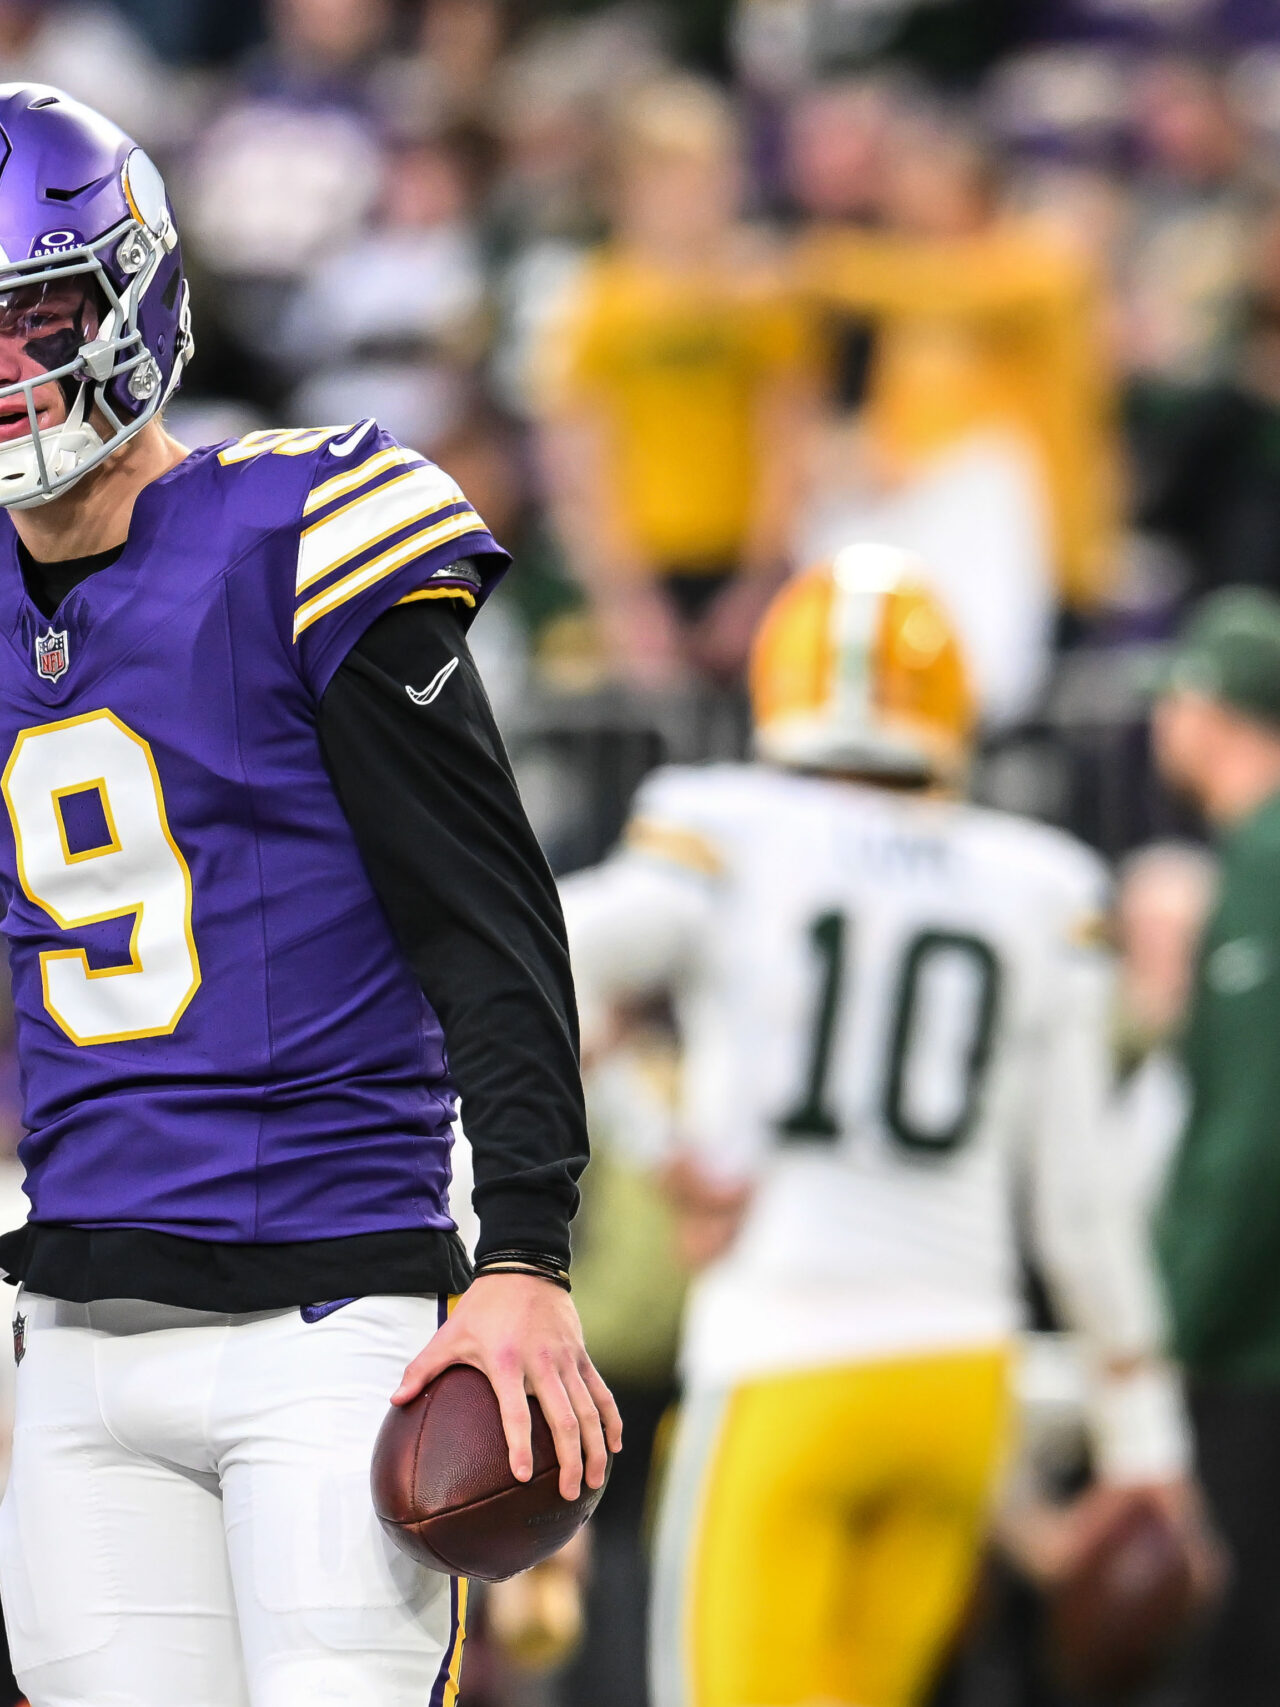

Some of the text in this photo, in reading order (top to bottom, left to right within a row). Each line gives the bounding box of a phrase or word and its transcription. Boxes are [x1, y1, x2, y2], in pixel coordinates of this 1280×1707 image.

[41, 650, 65, 673] NFL
[0, 707, 202, 1047] 9
[773, 908, 1001, 1155] 10
